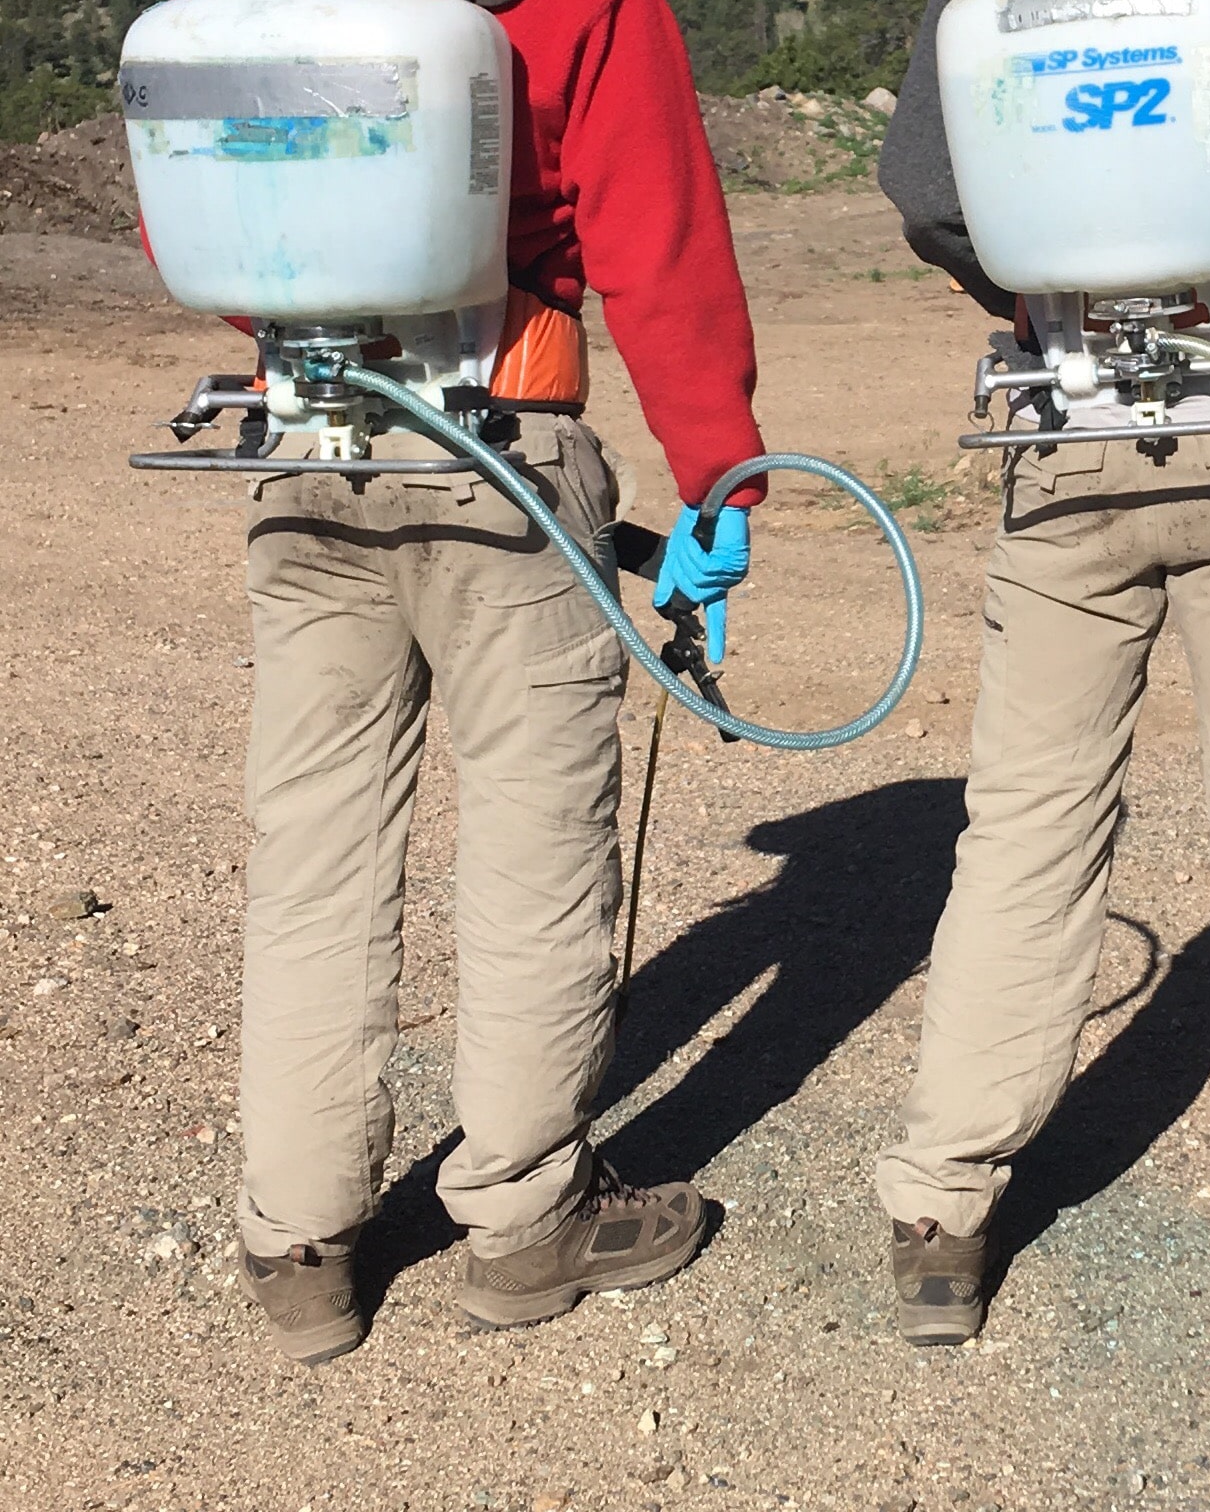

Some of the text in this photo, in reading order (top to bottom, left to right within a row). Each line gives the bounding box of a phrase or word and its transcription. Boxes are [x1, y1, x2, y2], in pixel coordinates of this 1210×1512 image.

[1047, 45, 1178, 70] SP Systems
[1062, 77, 1171, 133] SP2
